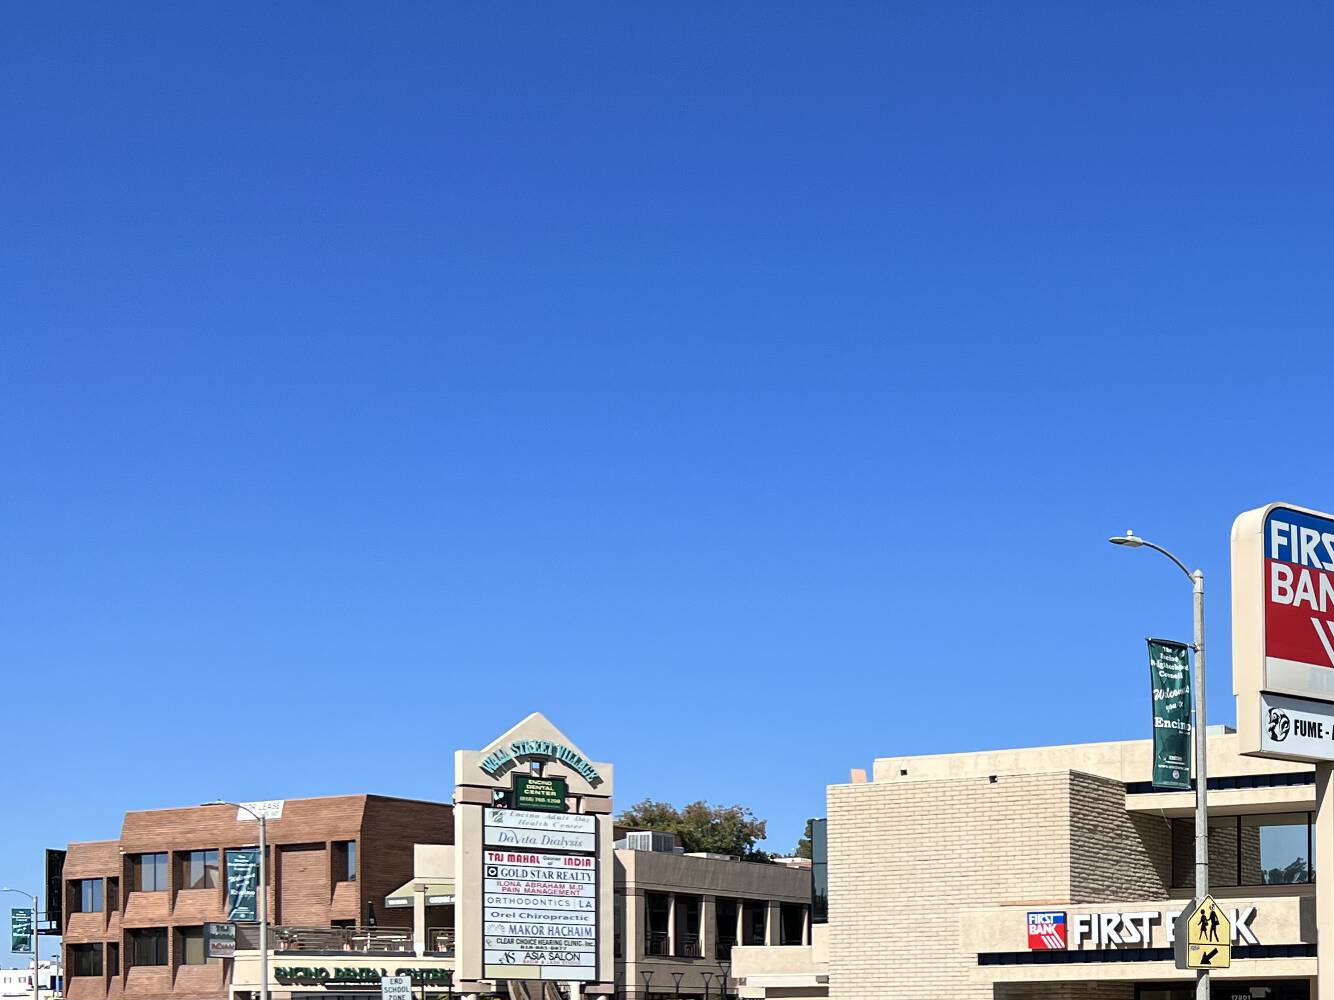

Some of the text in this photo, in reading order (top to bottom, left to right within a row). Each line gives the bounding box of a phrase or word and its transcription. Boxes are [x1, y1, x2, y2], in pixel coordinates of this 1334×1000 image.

[1154, 717, 1191, 731] Encino
[1294, 719, 1323, 739] FUME
[511, 740, 553, 757] STREET
[556, 743, 598, 782] VILLAGE
[523, 789, 557, 797] CENTER
[498, 830, 583, 849] DaVita Dialysis
[488, 853, 503, 863] TAJ
[507, 854, 541, 865] MAHAL
[564, 858, 592, 868] INDIA
[500, 868, 592, 882] GOLD STAR REALTY
[524, 882, 566, 890] ABRAHAM
[524, 888, 581, 896] MANAGEMENT
[487, 897, 593, 909] ORTHODONTICS LA
[490, 911, 590, 921] Orel Chiropractic
[1029, 913, 1064, 925] FIRST
[509, 924, 593, 937] MAKOR HACHAIM
[1029, 923, 1057, 936] BANK
[1073, 907, 1259, 947] FIRST BK
[524, 952, 547, 961] ASIA
[548, 952, 581, 961] SALON
[384, 986, 409, 994] SCHOOL
